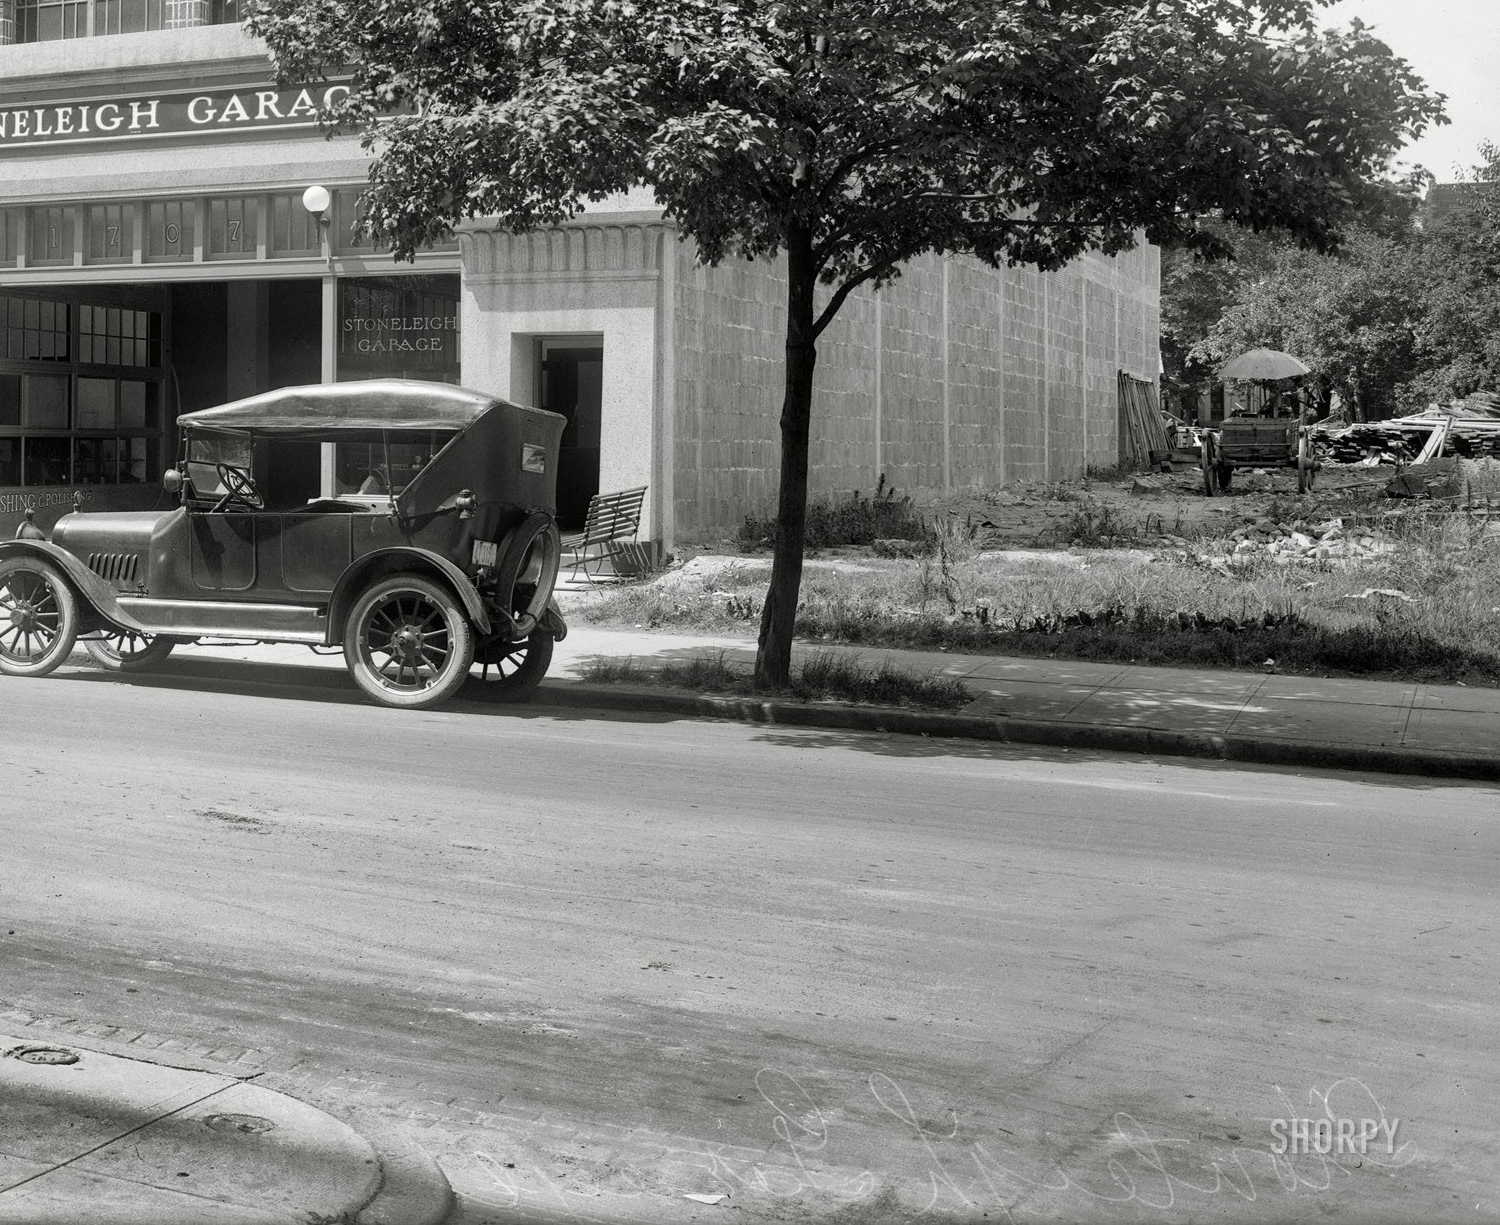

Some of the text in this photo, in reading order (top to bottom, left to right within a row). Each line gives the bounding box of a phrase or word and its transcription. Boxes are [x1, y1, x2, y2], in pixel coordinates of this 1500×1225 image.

[343, 316, 457, 332] STONELEIGH
[358, 337, 443, 352] GARAGE
[46, 492, 92, 507] POLISHNG
